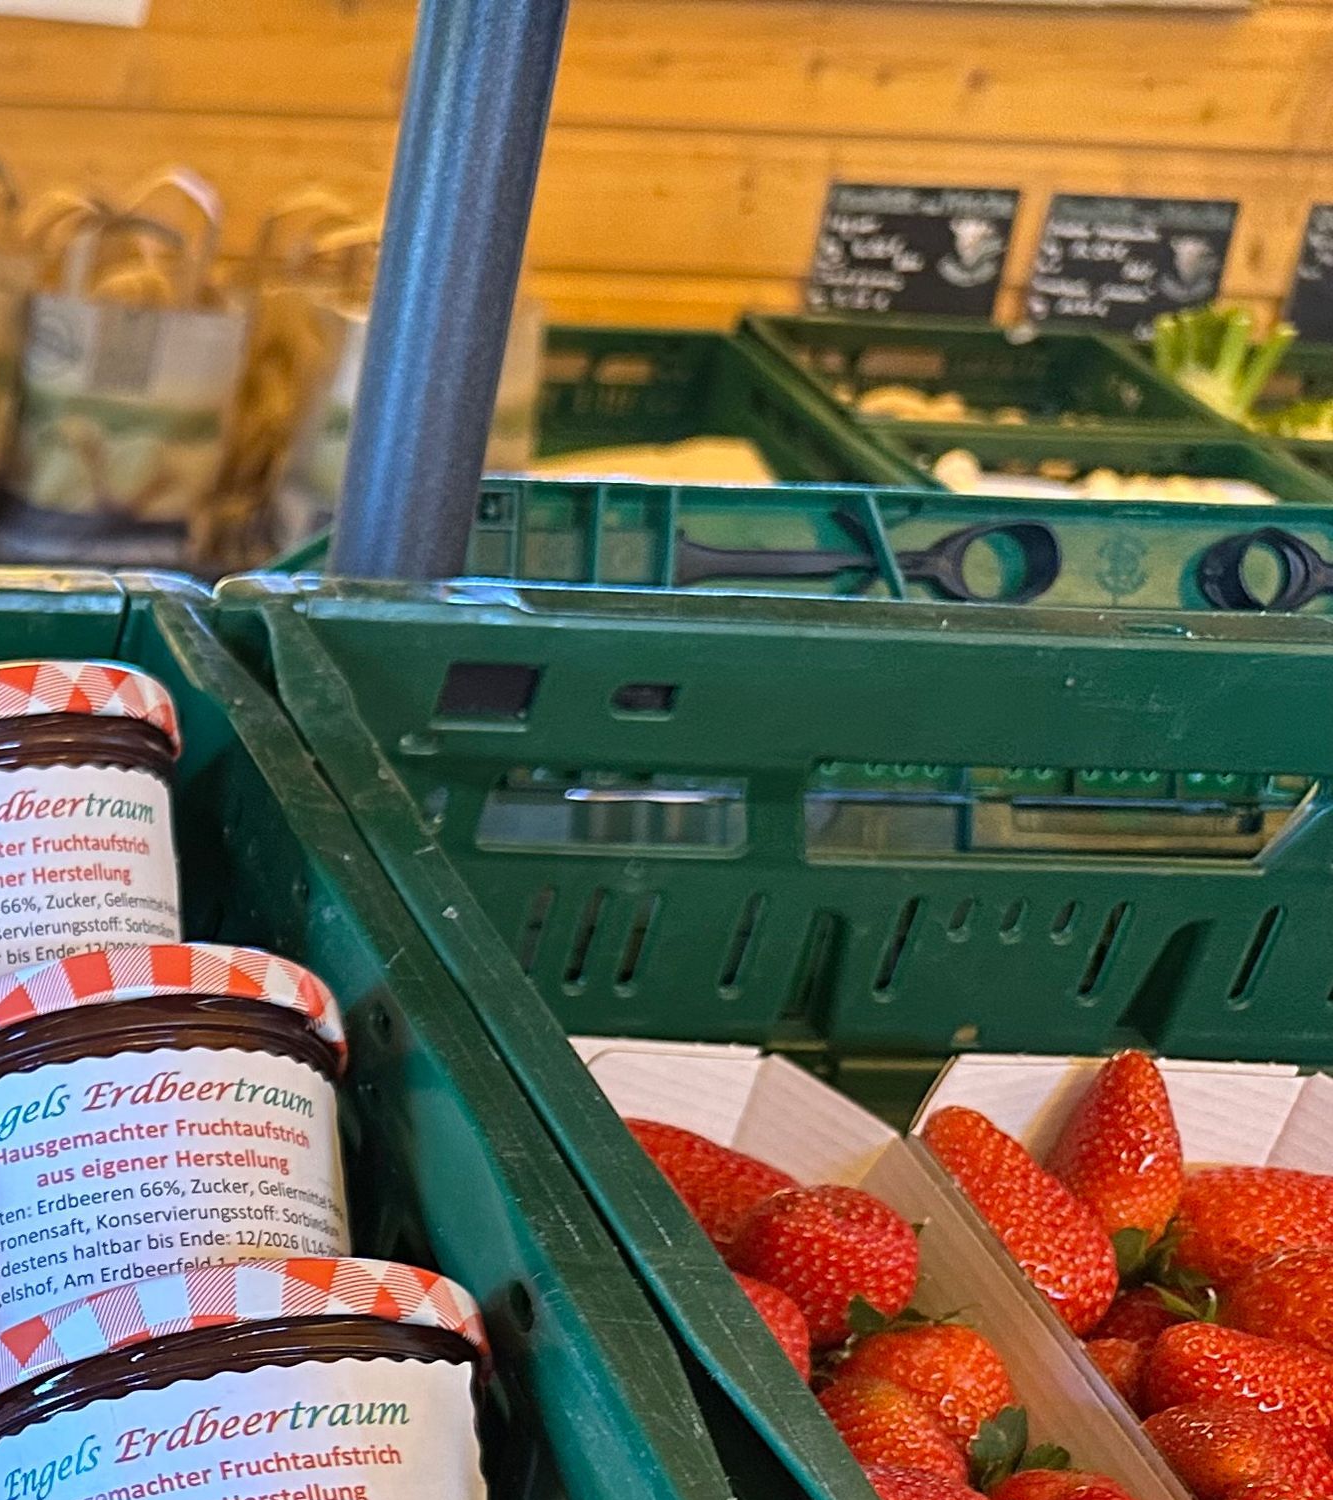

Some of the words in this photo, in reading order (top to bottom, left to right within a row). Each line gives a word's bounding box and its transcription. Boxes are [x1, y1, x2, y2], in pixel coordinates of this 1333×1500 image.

[32, 834, 151, 856] Fruchtaufstrich
[32, 863, 132, 887] Herstellung
[1, 897, 41, 915] 66%,
[45, 892, 102, 911] Zucker,
[7, 950, 30, 965] bis
[81, 1071, 314, 1118] Erdbeertraum
[175, 1118, 310, 1149] Fruchtaufstrich
[37, 1167, 75, 1187] aus
[81, 1155, 168, 1179] eigener
[175, 1149, 290, 1175] Herstellung
[37, 1187, 134, 1216] Erdbeeren
[140, 1179, 186, 1198] 66%,
[191, 1178, 254, 1197] Zucker,
[96, 1205, 279, 1230] Konservierungsstoff:
[73, 1238, 142, 1260] haltbar
[147, 1234, 174, 1250] bis
[180, 1230, 231, 1247] Ende:
[236, 1230, 299, 1250] 12/2026
[63, 1272, 94, 1290] Am
[100, 1256, 210, 1283] Erdbeerfeld
[114, 1401, 410, 1464] Erdbeertraum
[219, 1444, 402, 1480] Fruchtaufstrich
